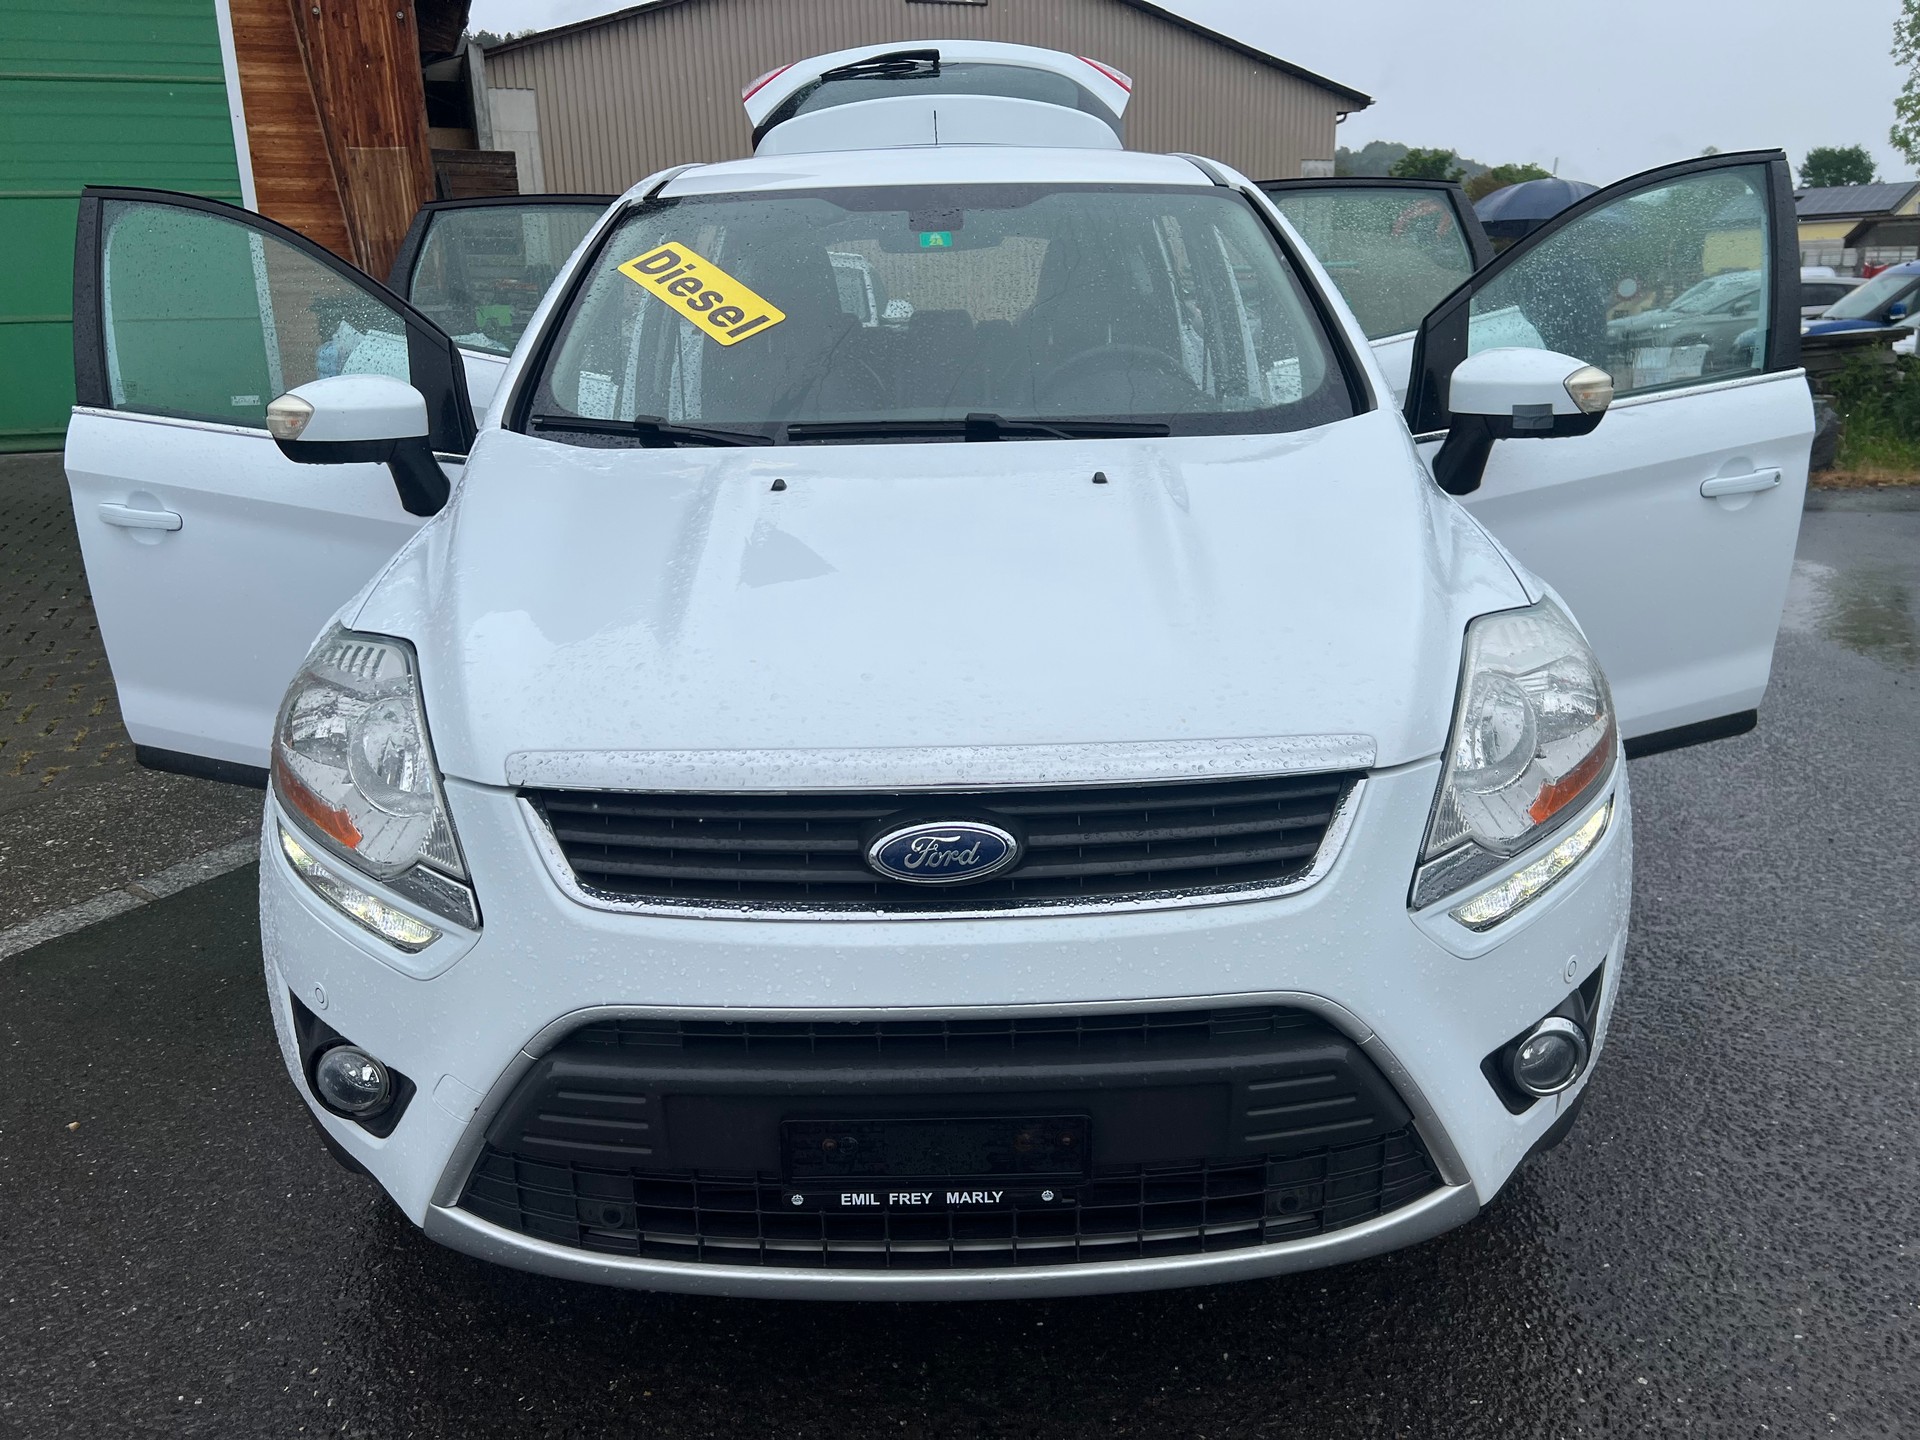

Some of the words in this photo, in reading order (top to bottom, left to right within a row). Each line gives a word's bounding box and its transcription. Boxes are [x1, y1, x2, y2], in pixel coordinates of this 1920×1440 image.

[632, 248, 771, 339] Diesel
[903, 835, 981, 869] Ford
[840, 1193, 880, 1206] EMIL
[889, 1192, 933, 1205] FREY
[946, 1190, 1004, 1204] MARLY
